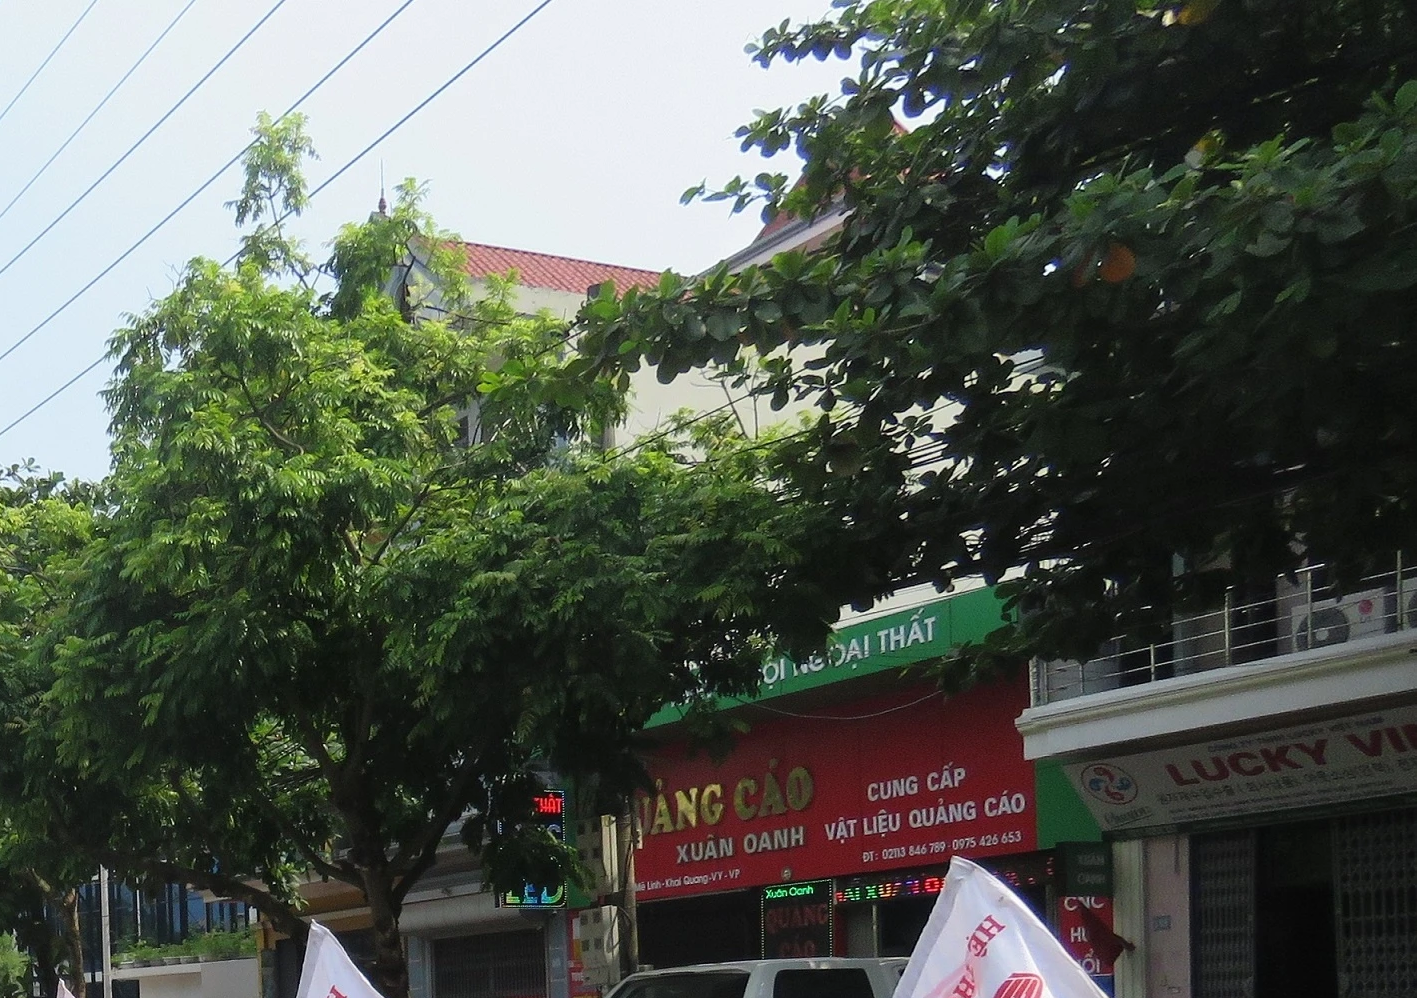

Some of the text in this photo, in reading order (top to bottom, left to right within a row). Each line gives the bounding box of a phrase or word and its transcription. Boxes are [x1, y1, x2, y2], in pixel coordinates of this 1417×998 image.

[877, 608, 936, 654] THẤT
[867, 761, 966, 802] CUNG CẤP
[1165, 738, 1328, 787] LUCKY
[734, 758, 814, 821] CÁO
[824, 790, 1026, 844] VẬT LIỆU QUẢNG CÁO
[677, 826, 804, 864] XUÂN OANH
[882, 846, 906, 860] 02113
[908, 844, 927, 857] 846
[929, 841, 946, 854] 789
[952, 837, 976, 850] 0975
[979, 834, 999, 847] 426
[1001, 830, 1022, 844] 653
[765, 885, 814, 899] Xuân Oanh
[966, 915, 1007, 957] HỆ
[1077, 949, 1100, 973] ỔI
